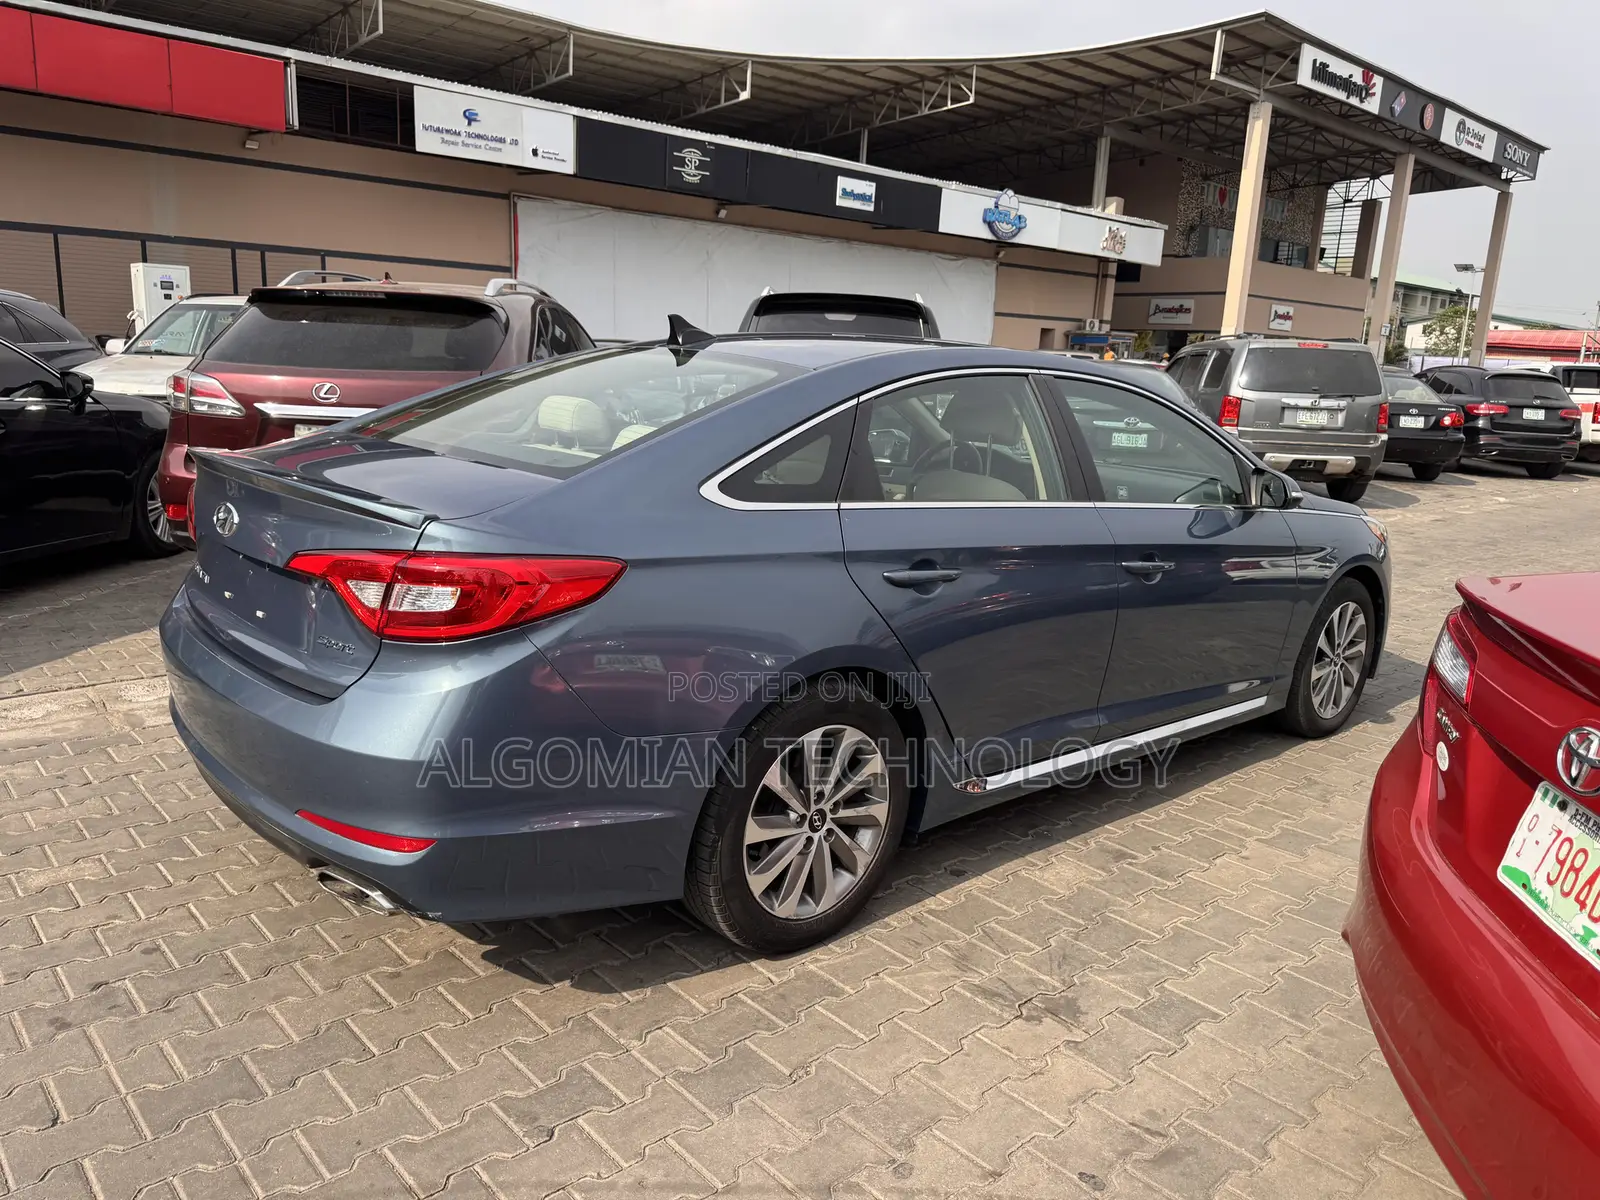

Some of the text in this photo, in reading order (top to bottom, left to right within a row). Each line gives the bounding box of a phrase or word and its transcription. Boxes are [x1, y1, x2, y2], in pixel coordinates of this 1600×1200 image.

[421, 123, 519, 146] FUTUREWORK TECHNOLOGIES LTD
[440, 137, 459, 147] Repair
[461, 140, 482, 149] Service
[684, 157, 699, 170] SP
[1503, 142, 1531, 167] SONY
